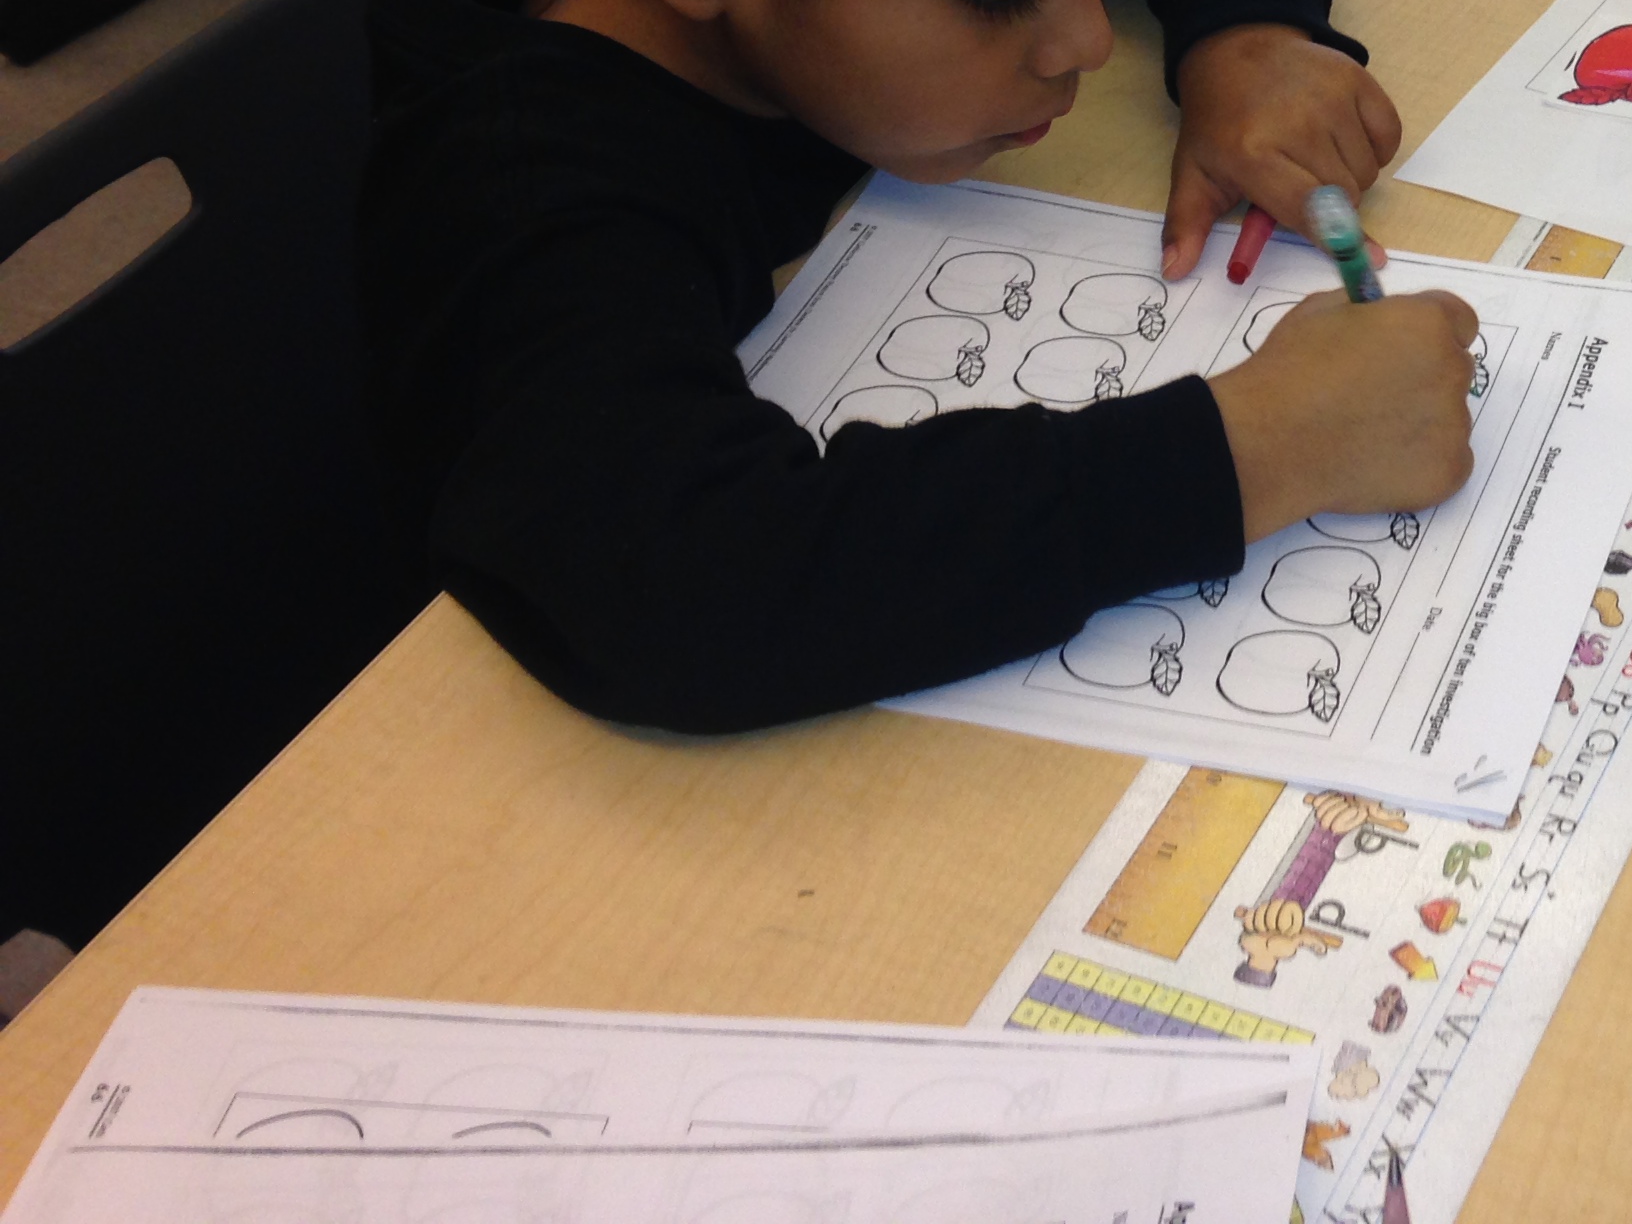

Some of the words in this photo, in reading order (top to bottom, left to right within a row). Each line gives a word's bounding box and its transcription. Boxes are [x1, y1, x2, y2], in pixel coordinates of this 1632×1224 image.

[1571, 337, 1609, 399] Appendix
[1535, 446, 1561, 483] Student
[1513, 485, 1543, 531] recording
[1503, 534, 1524, 562] sheet
[1496, 563, 1513, 580] for
[1486, 581, 1504, 599] the
[1422, 607, 1442, 631] Date
[1475, 601, 1497, 620] big
[1469, 621, 1488, 640] box
[1463, 643, 1476, 657] of
[1454, 658, 1471, 677] ten
[1420, 679, 1464, 756] investigation
[1539, 813, 1578, 843] Rr
[1512, 862, 1550, 893] Ss
[1434, 1015, 1480, 1048] Vv
[1396, 1067, 1452, 1121] Ww
